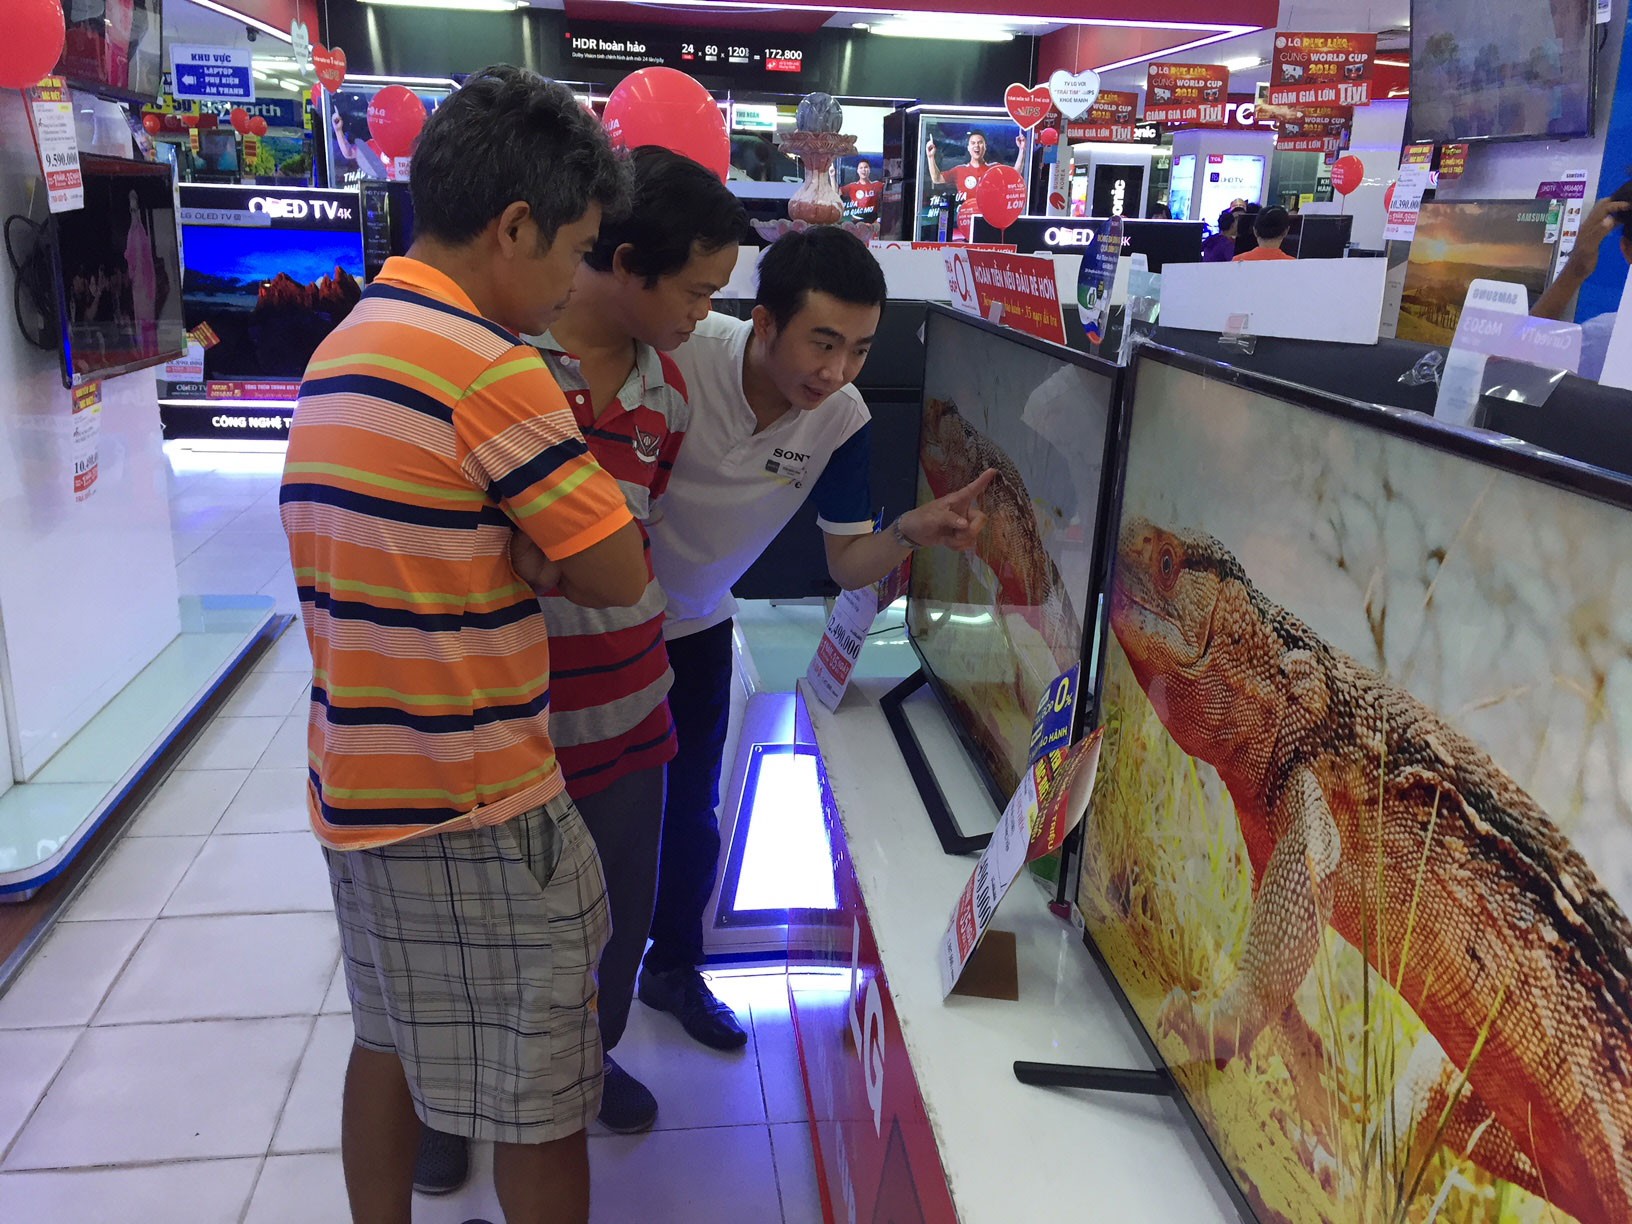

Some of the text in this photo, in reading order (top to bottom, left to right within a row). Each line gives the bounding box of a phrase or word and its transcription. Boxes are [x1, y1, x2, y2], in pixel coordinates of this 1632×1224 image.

[572, 37, 646, 53] HDR hoàn hảo
[1288, 38, 1300, 47] LG
[681, 44, 694, 53] 24
[705, 45, 718, 54] 60
[728, 47, 746, 56] 120
[764, 49, 802, 60] 172,800
[1280, 51, 1368, 62] CÙNG WORLD CUP
[191, 53, 231, 65] KHU VỰC
[204, 67, 233, 75] LAPTOP
[1309, 64, 1338, 74] 2018
[1206, 80, 1223, 88] CUP
[1175, 88, 1199, 97] 2018
[1272, 90, 1297, 105] GIẢM
[1299, 88, 1316, 103] GIÁ
[1318, 87, 1335, 101] LỚN
[375, 108, 386, 116] LG
[1146, 109, 1166, 120] GIẢM
[1168, 108, 1181, 119] GIÁ
[1183, 107, 1197, 119] LỚN
[45, 153, 78, 168] 9.590.000
[309, 199, 338, 219] TV
[338, 208, 352, 219] 4K
[194, 211, 219, 221] OLED
[220, 212, 232, 221] TV
[974, 260, 1056, 300] HOÀN TIỀN NẾU ĐÂU RẺ HƠN
[211, 415, 247, 428] CÔNG
[248, 415, 283, 429] NGHỆ
